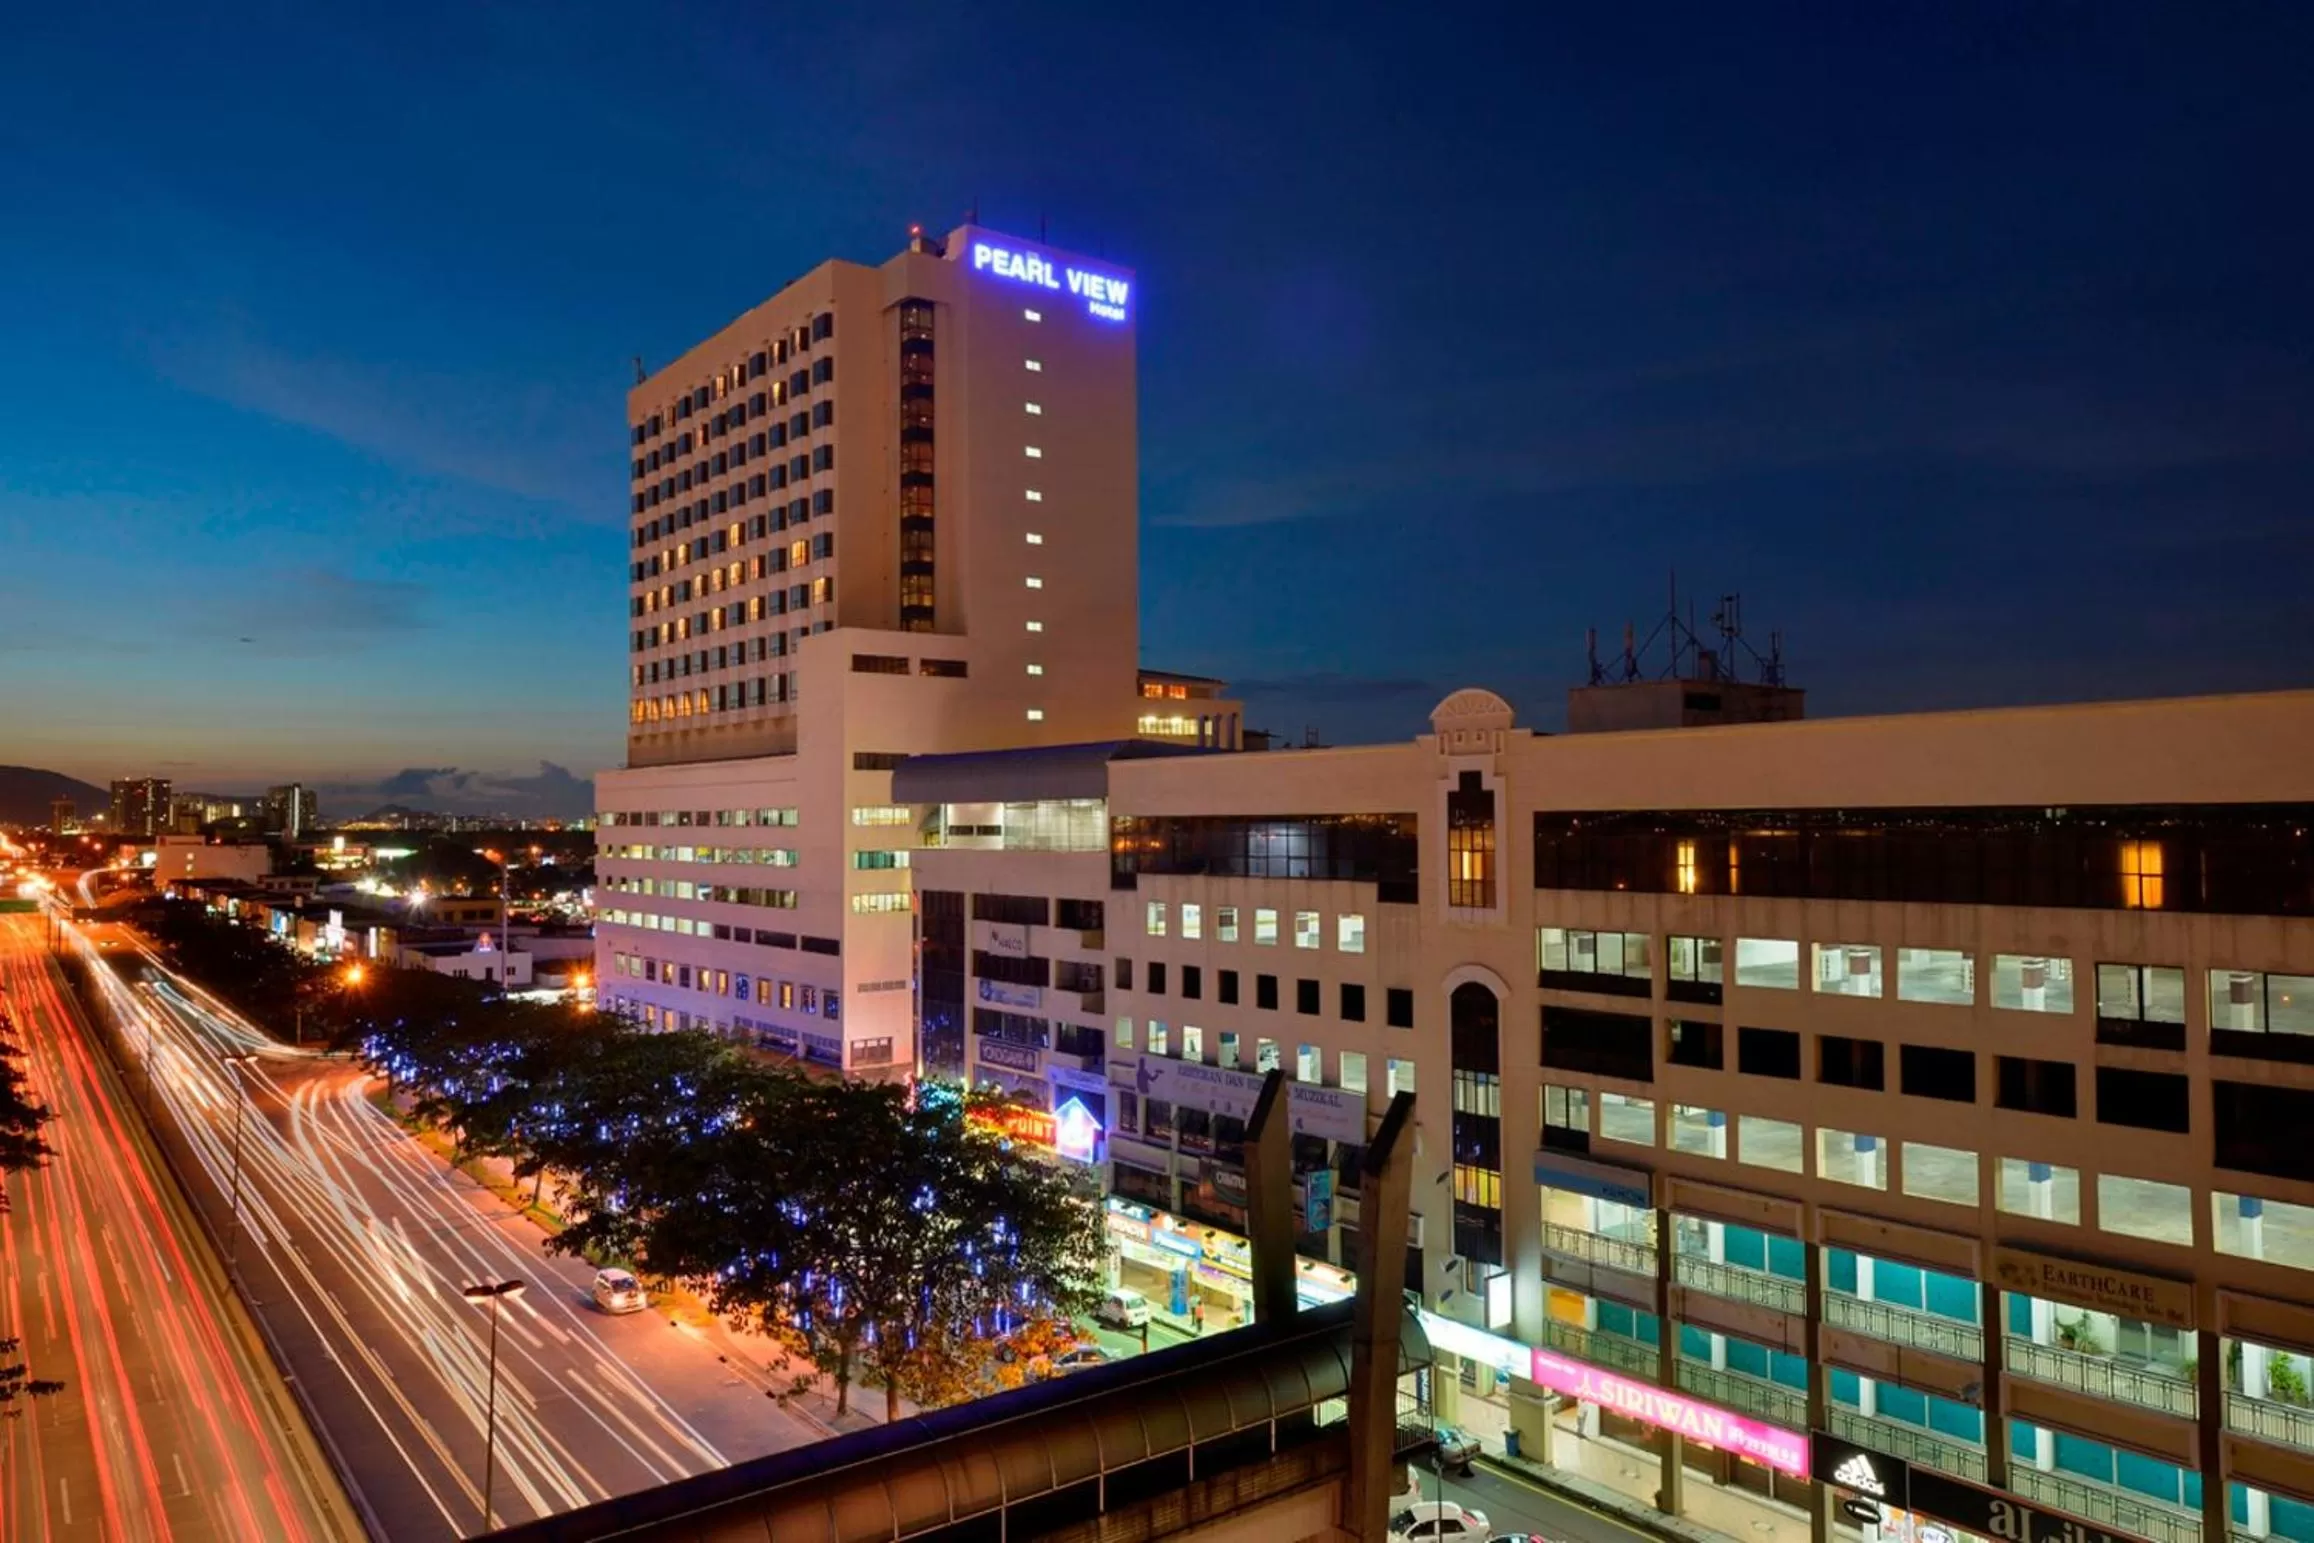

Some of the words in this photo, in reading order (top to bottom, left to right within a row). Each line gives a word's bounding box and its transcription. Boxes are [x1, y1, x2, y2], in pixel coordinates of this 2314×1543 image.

[974, 243, 1060, 289] PEARL
[1065, 268, 1129, 305] VIEW
[1089, 301, 1125, 320] Hotel
[1599, 1379, 1723, 1442] SIRIWAN
